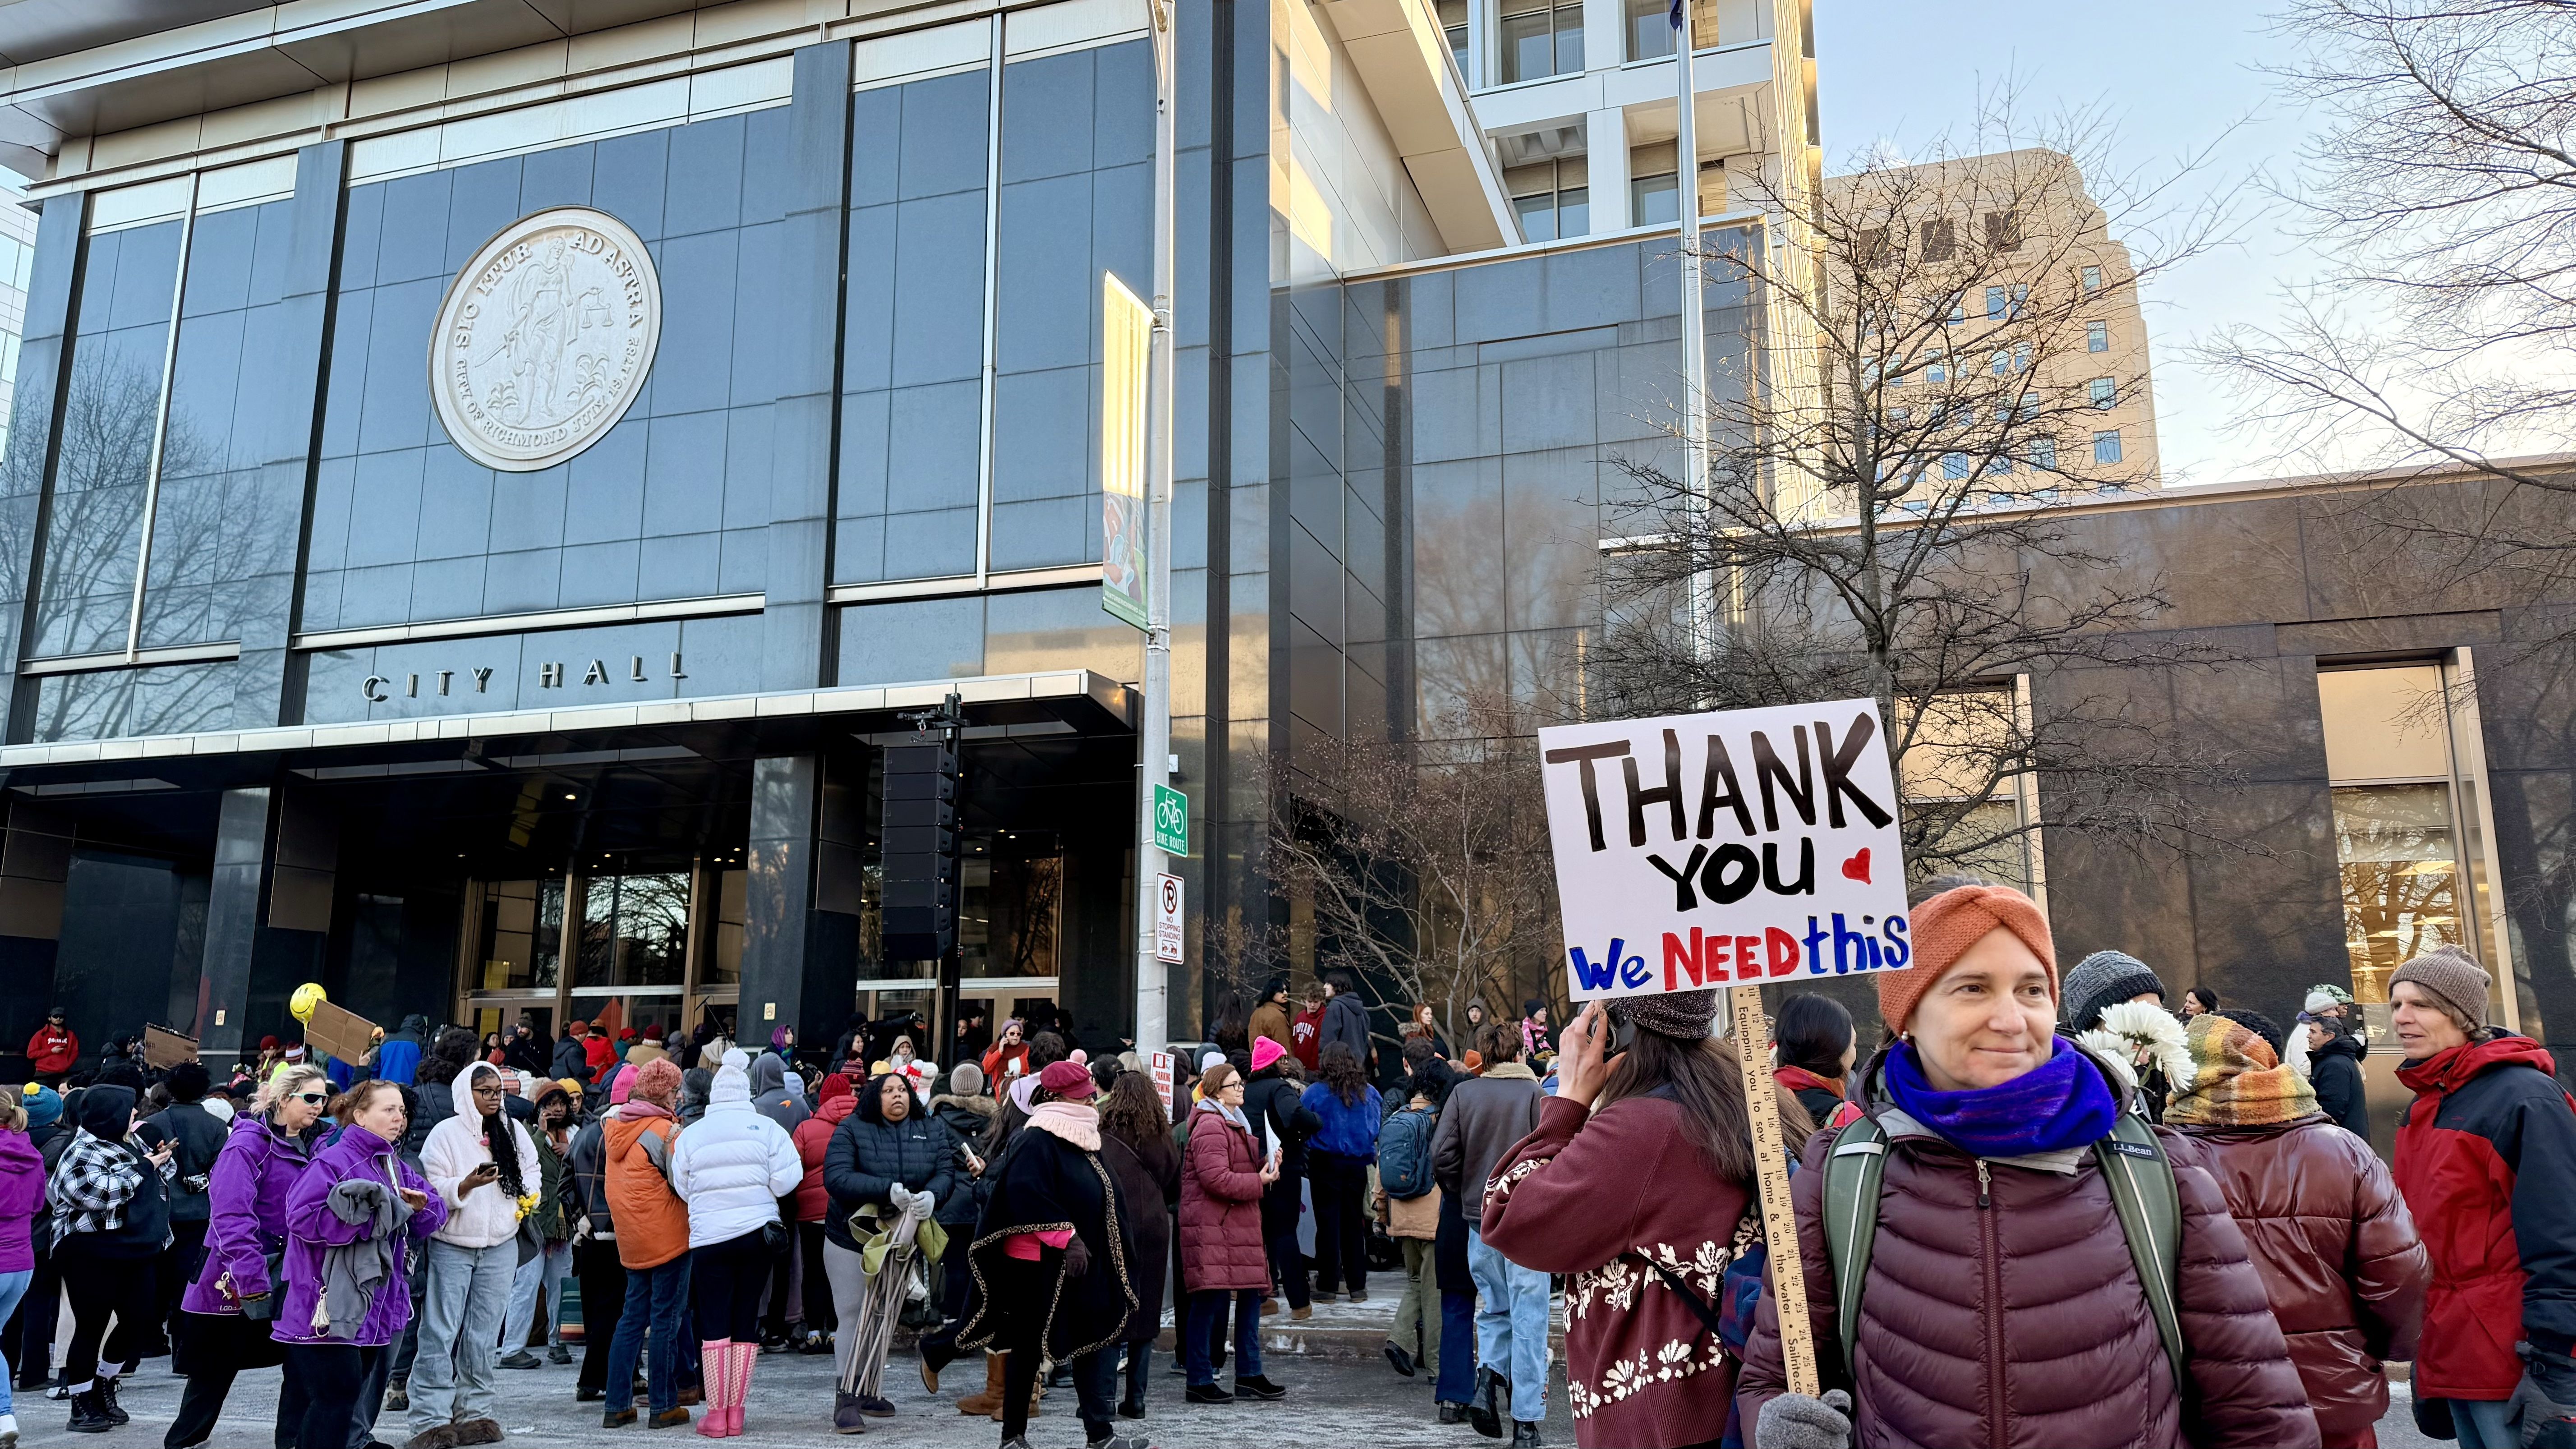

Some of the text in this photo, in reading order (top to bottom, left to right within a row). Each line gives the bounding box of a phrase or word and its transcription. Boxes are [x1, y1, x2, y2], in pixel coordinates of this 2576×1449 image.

[454, 231, 643, 350] SIC ITUR AD ASTRA
[467, 401, 484, 421] OF
[483, 418, 567, 446] RICHMOND
[362, 652, 683, 701] CITY HALL
[1546, 712, 1893, 852] THANK
[1157, 831, 1185, 851] BIKE ROUTE
[1646, 837, 1815, 912] YOU
[1159, 922, 1180, 933] STOPPING
[1159, 931, 1180, 941] STANDING
[1569, 913, 1909, 991] We NEED this
[1739, 1007, 1754, 1062] Equipping
[1746, 1070, 1757, 1091] you
[1753, 1101, 1761, 1112] to
[1756, 1122, 1765, 1143] sew
[1761, 1152, 1770, 1163] at
[2113, 1144, 2152, 1155] L.L.Bean
[1763, 1172, 1774, 1204] home
[1770, 1213, 1779, 1222] &
[1773, 1232, 1780, 1246] on
[1776, 1255, 1786, 1273] the
[1780, 1282, 1790, 1315] water
